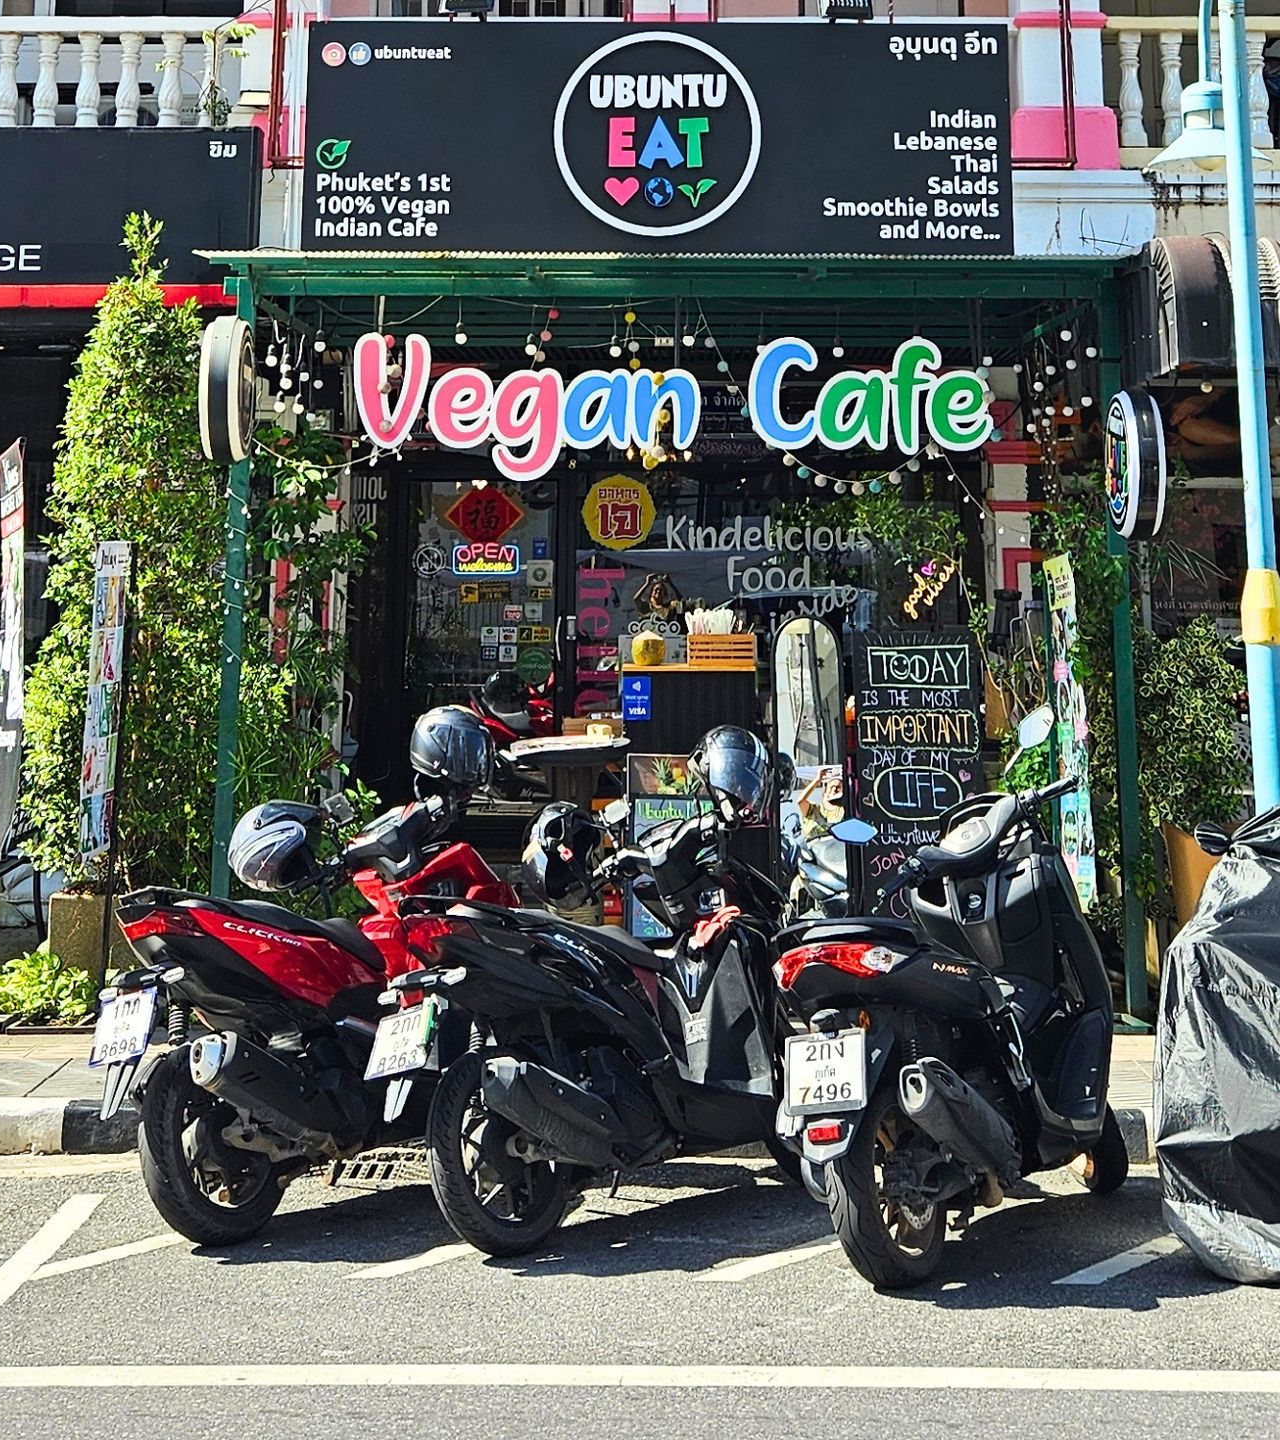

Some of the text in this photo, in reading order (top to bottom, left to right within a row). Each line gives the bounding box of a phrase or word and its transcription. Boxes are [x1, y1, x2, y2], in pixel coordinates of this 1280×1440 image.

[373, 45, 452, 60] ubuntueat
[888, 30, 998, 61] อุบุนตุ อีท
[588, 73, 728, 109] UBUNTU
[929, 109, 997, 128] Indian
[607, 113, 710, 169] EAT
[893, 130, 998, 151] Lebanese
[950, 153, 998, 173] Thai
[417, 173, 452, 192] 1st
[927, 175, 999, 195] Salads
[315, 195, 451, 218] 100% Vegan
[822, 196, 1000, 217] Smoothie Bowls
[314, 217, 439, 237] Indian Cafe
[879, 219, 1001, 240] and More...
[353, 331, 995, 481] Vegan Cafe
[466, 498, 502, 530] 福
[665, 515, 872, 552] Kindelicious
[456, 543, 515, 562] OPEN
[458, 558, 514, 572] welcome
[726, 555, 811, 593] Food
[903, 572, 927, 620] good
[871, 650, 965, 685] TODAY
[861, 689, 960, 707] IS THE MOST
[627, 707, 647, 716] VISA
[861, 713, 971, 746] IMPORTANT
[873, 748, 951, 771] DAY OF MY
[888, 771, 948, 810] LIFE
[637, 802, 683, 820] Ubuntu
[871, 848, 906, 877] JOIN
[222, 921, 282, 943] CLICK
[932, 962, 969, 976] NMAX
[377, 1049, 418, 1073] 8263
[799, 1081, 852, 1104] 7496
